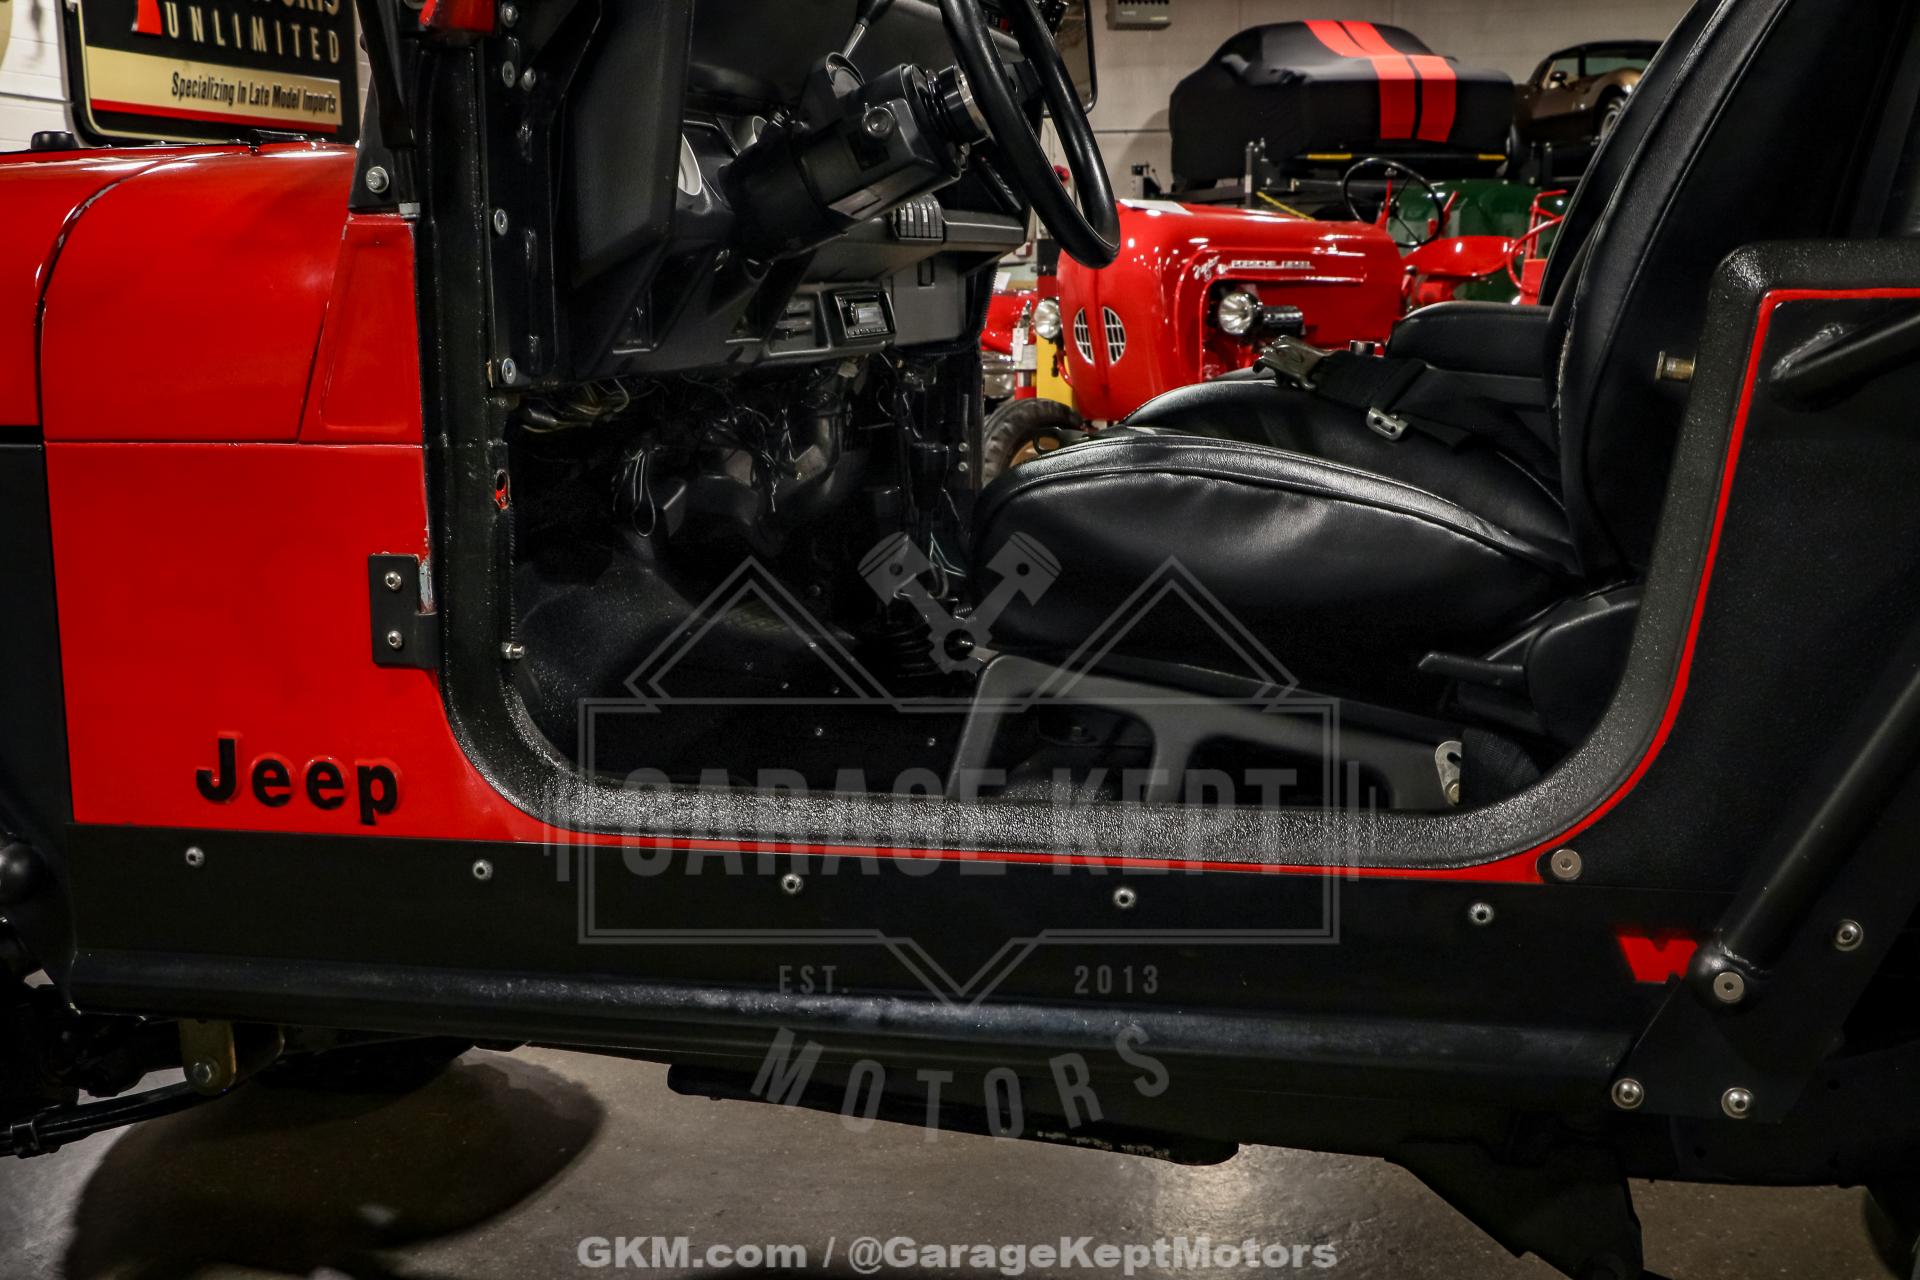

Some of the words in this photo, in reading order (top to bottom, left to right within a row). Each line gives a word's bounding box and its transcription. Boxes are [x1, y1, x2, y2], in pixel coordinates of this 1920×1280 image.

[165, 2, 340, 63] UNLIMITED
[172, 71, 235, 106] Specializing
[237, 80, 247, 105] In
[250, 82, 270, 106] Late
[271, 85, 300, 109] Model
[302, 86, 337, 116] Imports
[195, 736, 399, 826] Jeep
